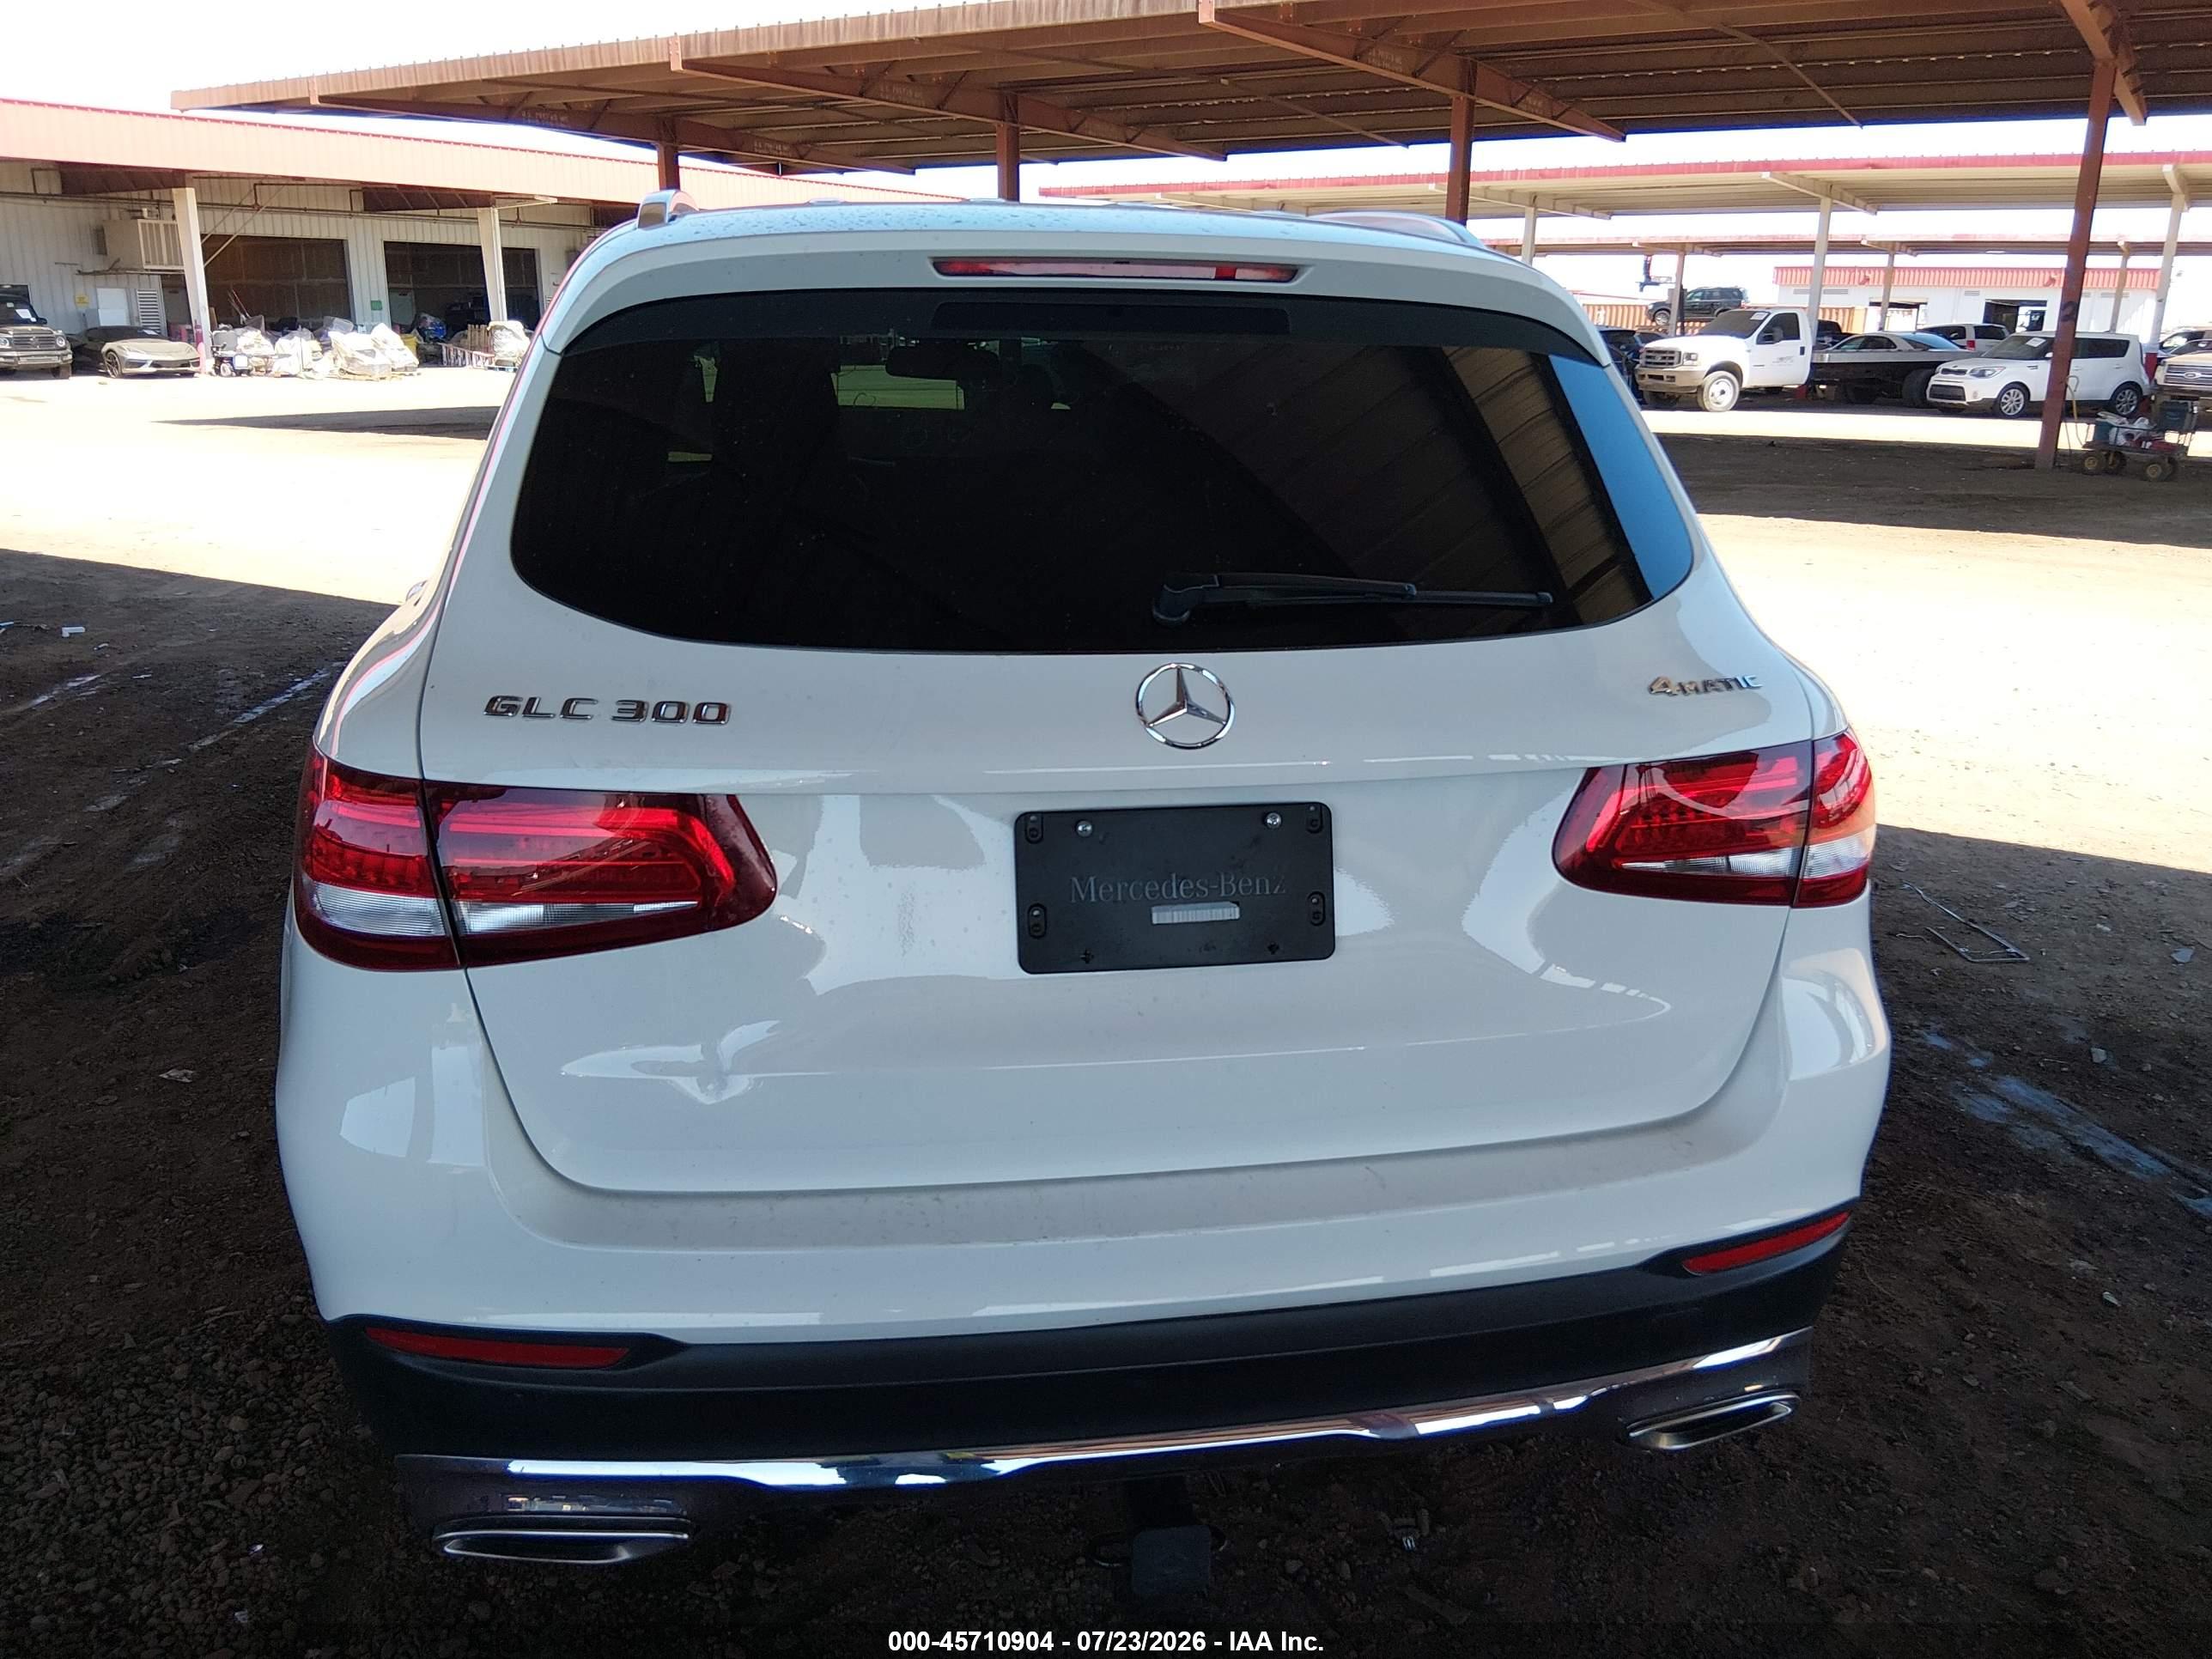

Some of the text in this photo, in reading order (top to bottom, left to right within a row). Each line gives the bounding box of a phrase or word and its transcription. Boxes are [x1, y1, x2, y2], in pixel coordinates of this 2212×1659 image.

[483, 694, 732, 726] GLC 300
[1071, 872, 1286, 903] Mercedes-Benz
